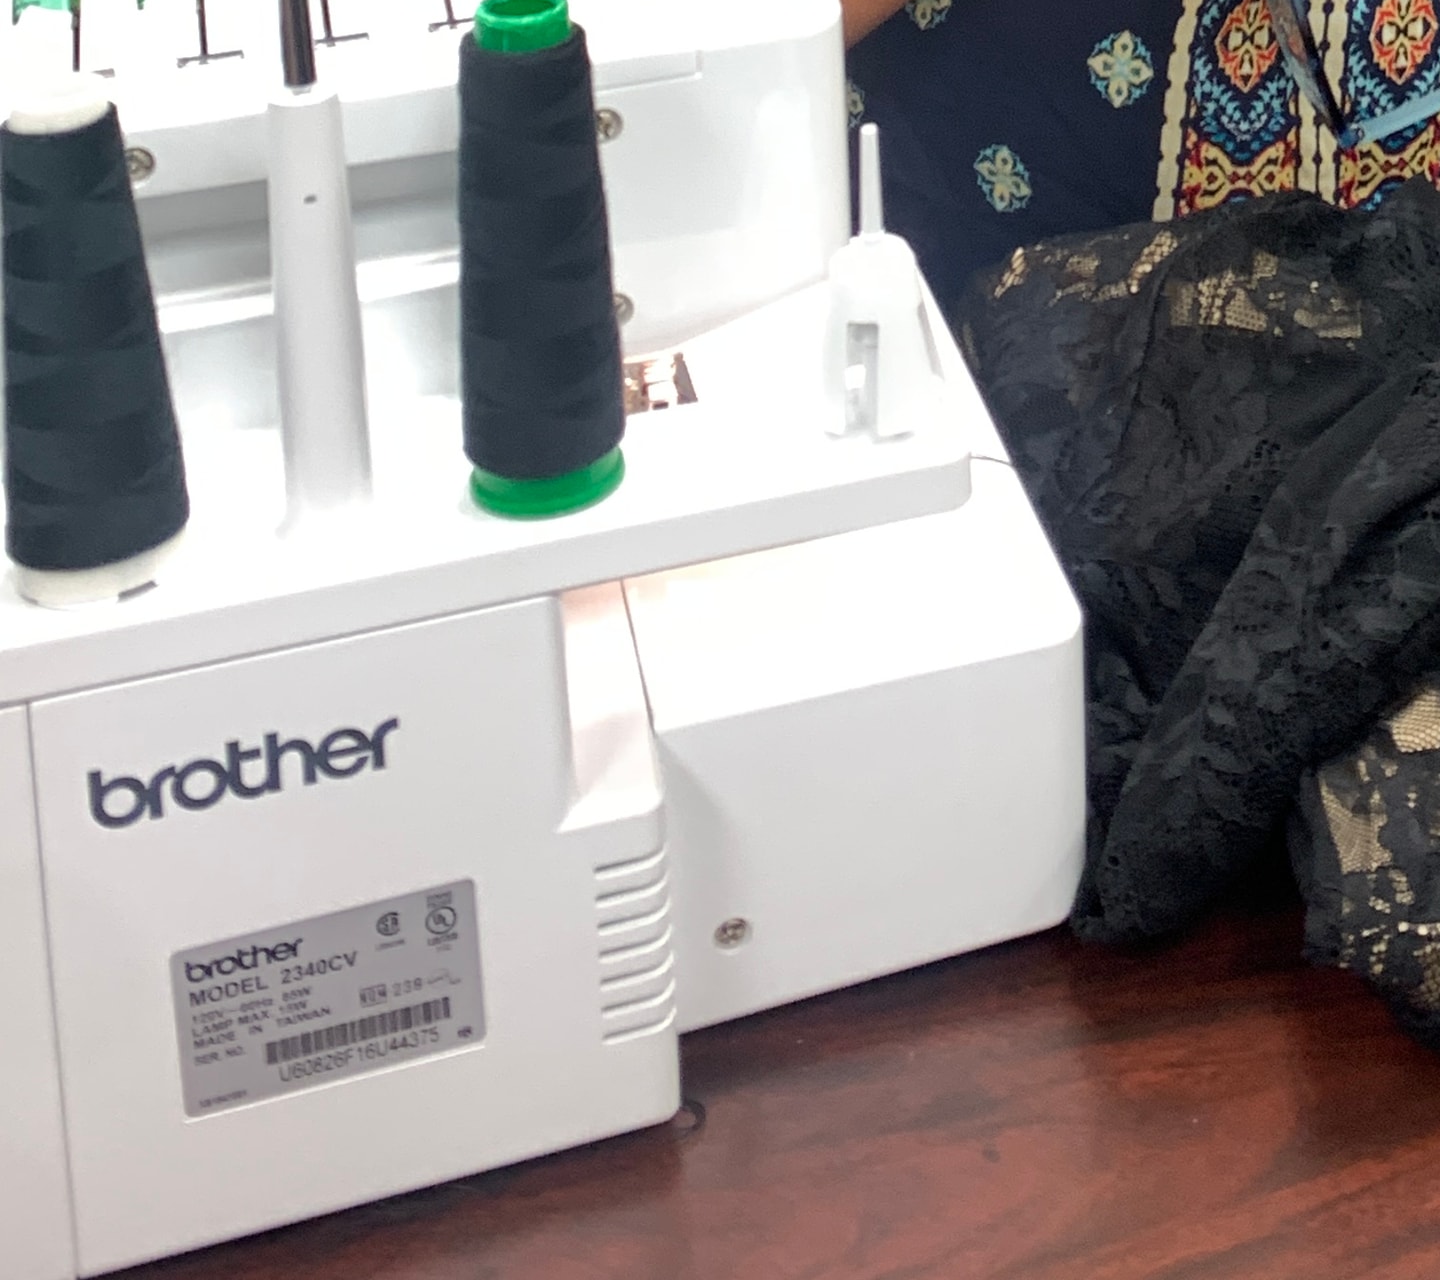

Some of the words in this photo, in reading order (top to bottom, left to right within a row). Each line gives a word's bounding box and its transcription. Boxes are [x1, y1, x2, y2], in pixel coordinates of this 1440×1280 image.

[87, 717, 401, 830] brother
[184, 938, 304, 983] brother
[189, 976, 269, 1007] MODEL
[280, 951, 358, 985] 2340CV
[193, 1031, 236, 1049] MADE
[276, 1007, 331, 1028] TAIWAN
